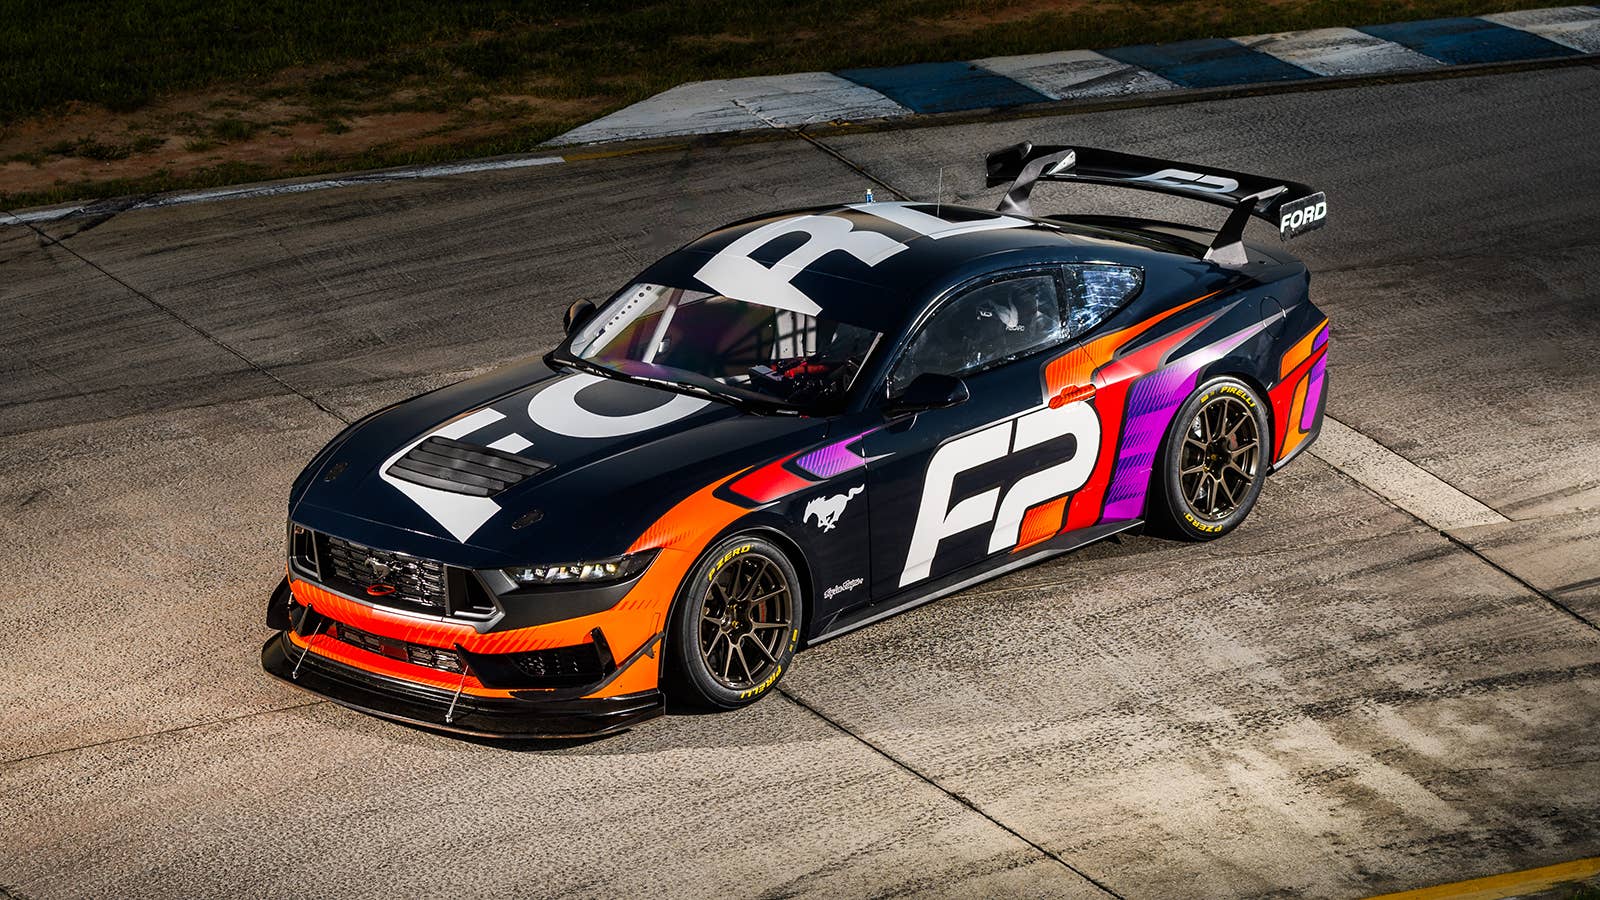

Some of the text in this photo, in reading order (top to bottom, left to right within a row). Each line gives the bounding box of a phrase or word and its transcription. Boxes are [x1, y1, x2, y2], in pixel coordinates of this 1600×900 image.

[1280, 201, 1327, 233] FORD
[1220, 386, 1256, 408] PIRELLI
[898, 401, 1102, 588] FP
[741, 664, 782, 698] PIRELLI
